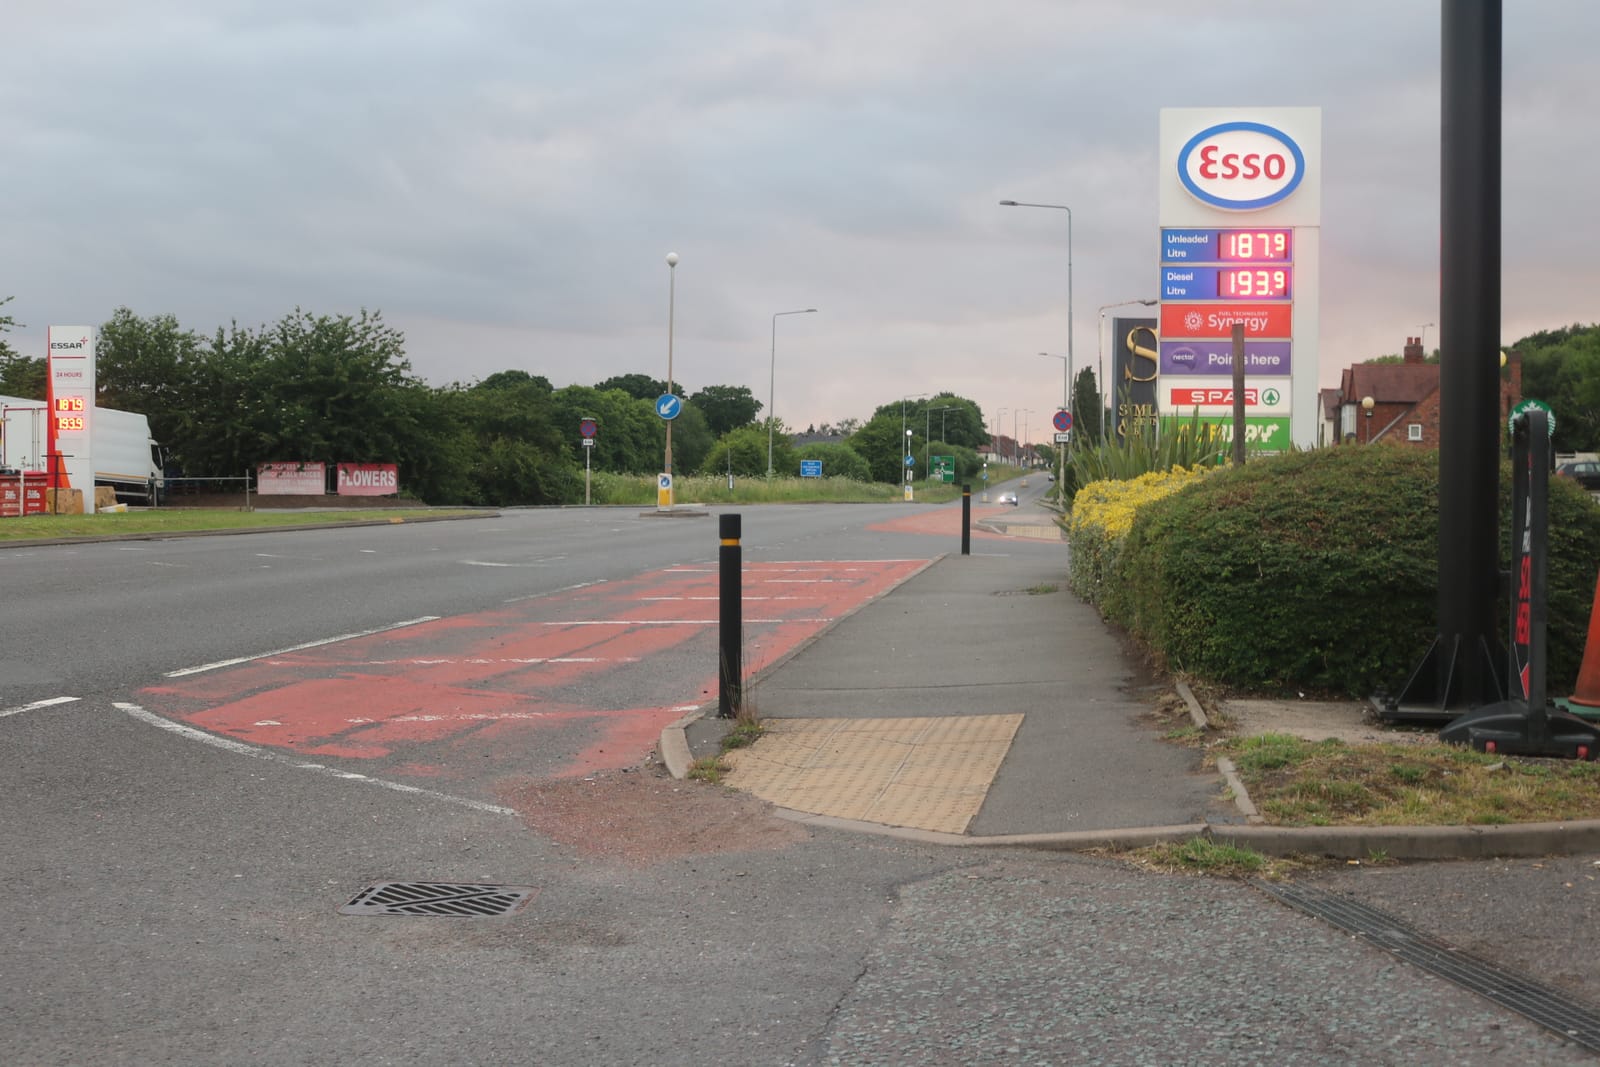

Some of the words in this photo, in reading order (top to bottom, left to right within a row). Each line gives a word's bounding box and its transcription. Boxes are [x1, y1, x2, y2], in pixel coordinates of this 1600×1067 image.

[1199, 145, 1286, 180] Esso
[1167, 234, 1208, 244] Unleaded
[1230, 233, 1285, 258] 187.9
[1167, 248, 1187, 258] Litre
[1167, 272, 1193, 281] Diesel
[1230, 271, 1285, 295] 193.9
[1167, 286, 1186, 295] Litre
[1208, 314, 1268, 331] Synergy
[1172, 353, 1195, 361] nectar
[1208, 353, 1248, 365] Pois
[1251, 353, 1280, 365] here
[339, 470, 396, 487] FLOWERS
